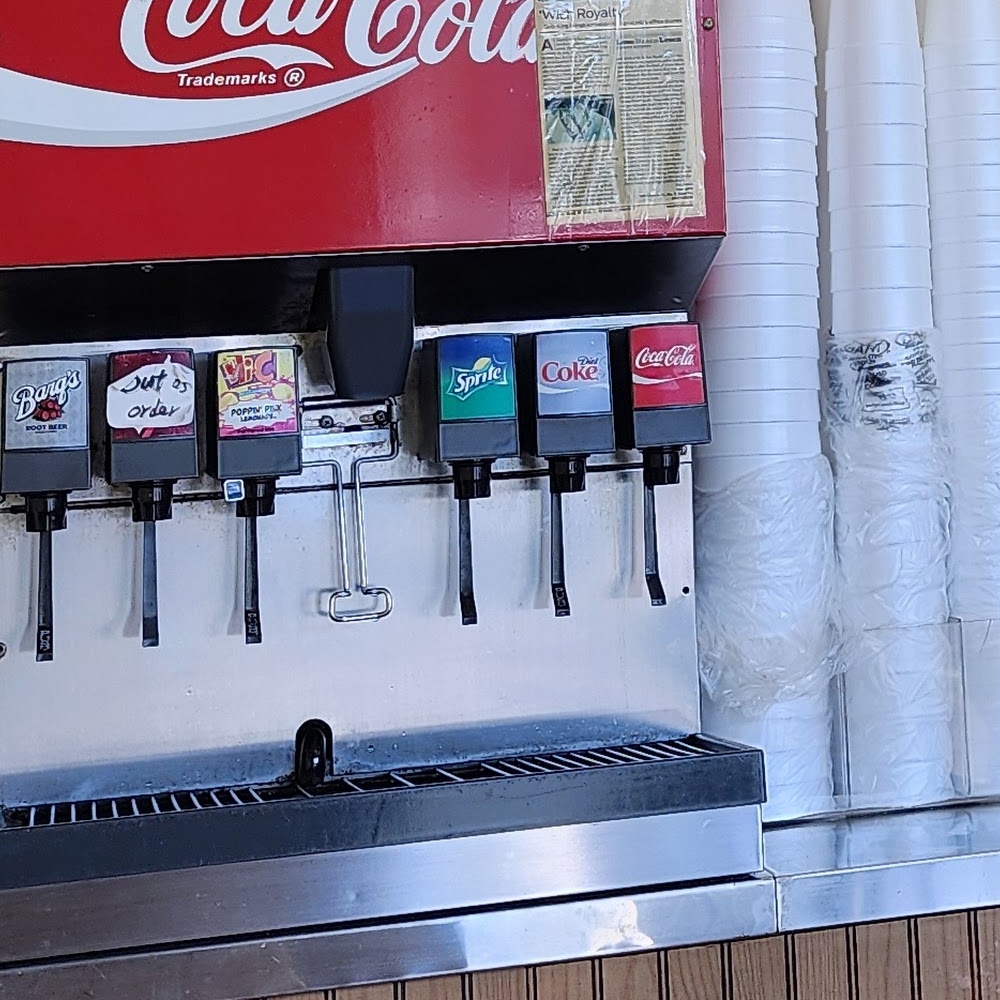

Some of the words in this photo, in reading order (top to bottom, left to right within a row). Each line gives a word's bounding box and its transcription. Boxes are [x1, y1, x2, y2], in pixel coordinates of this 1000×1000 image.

[177, 72, 276, 87] Trademarks
[578, 356, 599, 365] Diet
[635, 344, 697, 368] Coca-Cola
[454, 366, 502, 393] Sprite
[542, 361, 599, 382] Coke
[13, 370, 81, 421] Barq's
